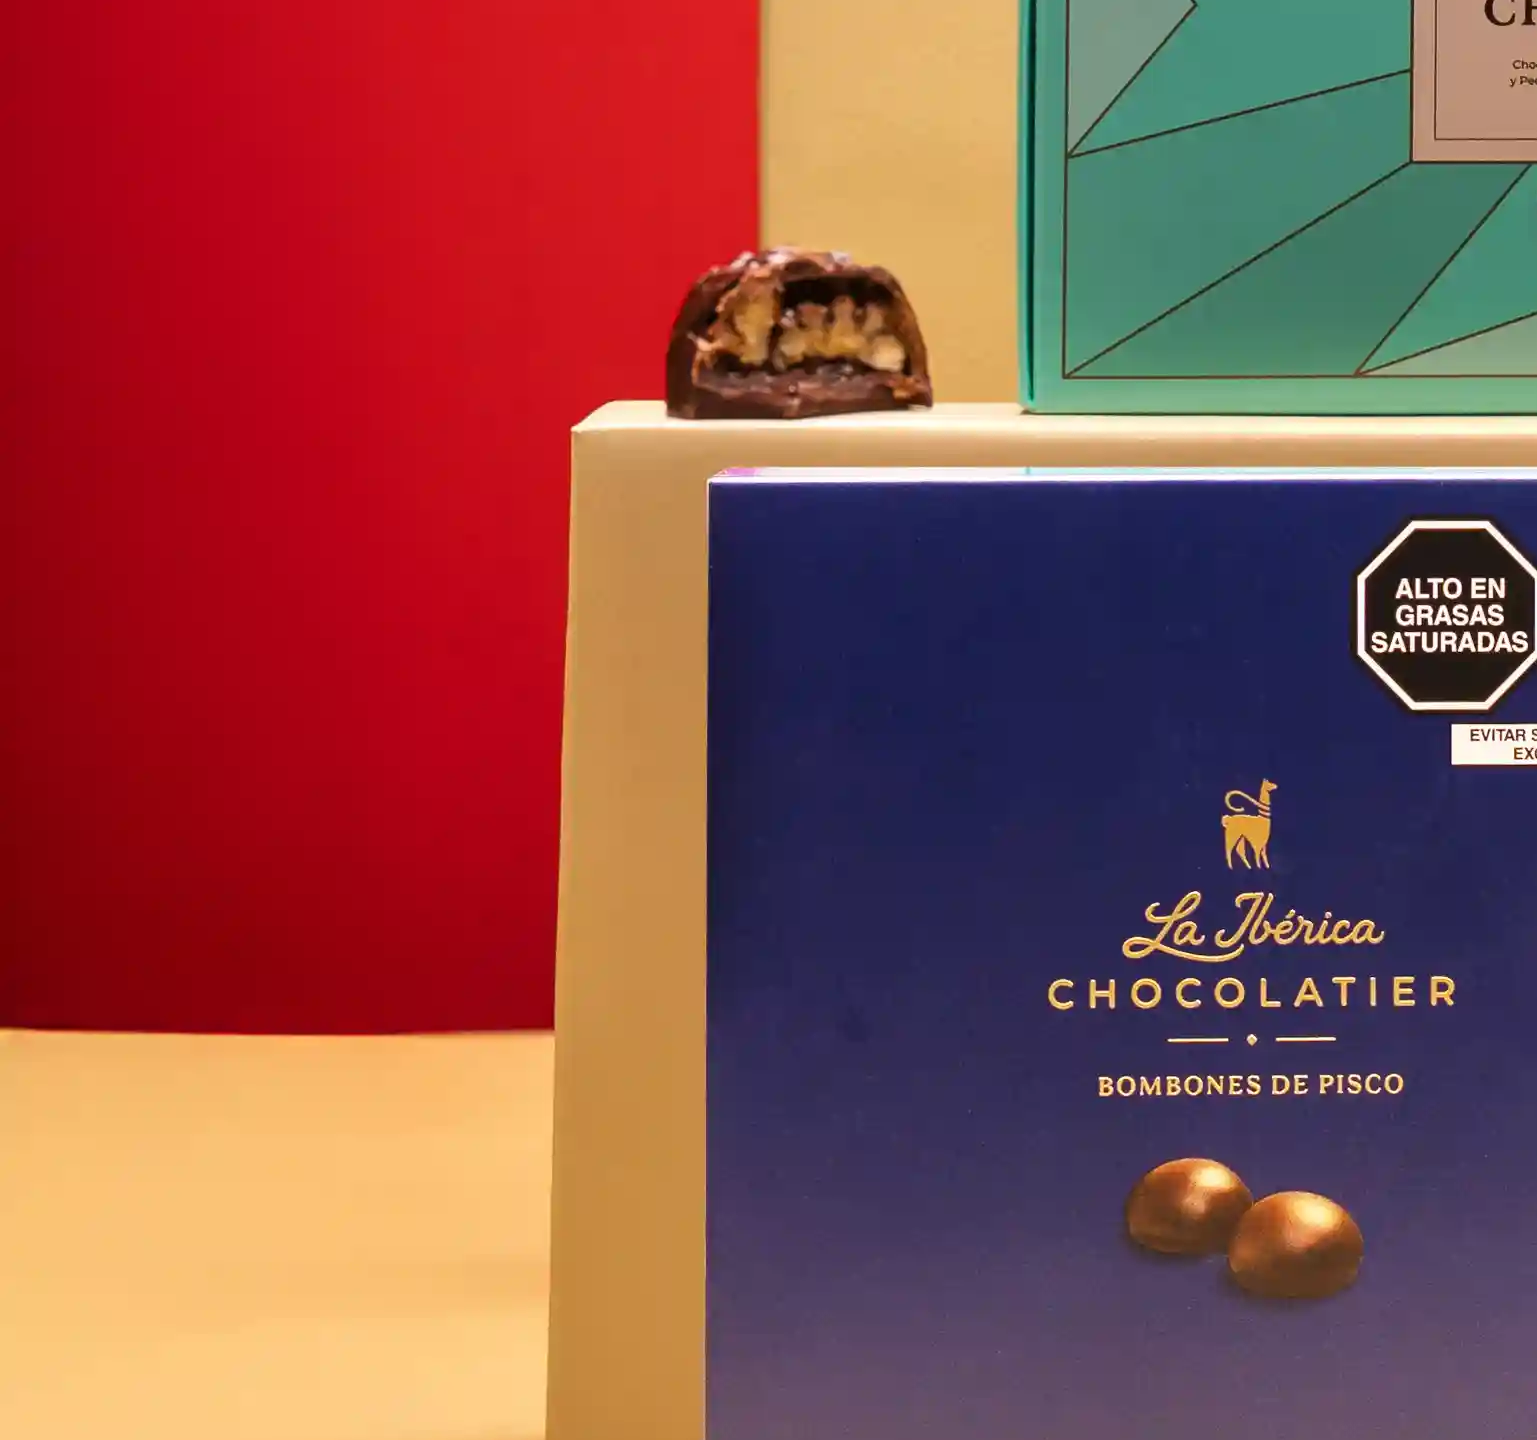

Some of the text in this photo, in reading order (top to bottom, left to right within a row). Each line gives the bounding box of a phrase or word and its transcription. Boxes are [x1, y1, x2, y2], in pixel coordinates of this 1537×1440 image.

[1509, 77, 1518, 88] y
[1396, 578, 1505, 599] ALTO EN
[1396, 605, 1504, 626] GRASAS
[1371, 631, 1529, 653] SATURADAS
[1470, 729, 1526, 742] EVITAR
[1122, 891, 1384, 962] La Ibérica
[1047, 975, 1456, 1010] CHOCOLATIER
[1098, 1073, 1404, 1097] BOMBONES DE PISCO
